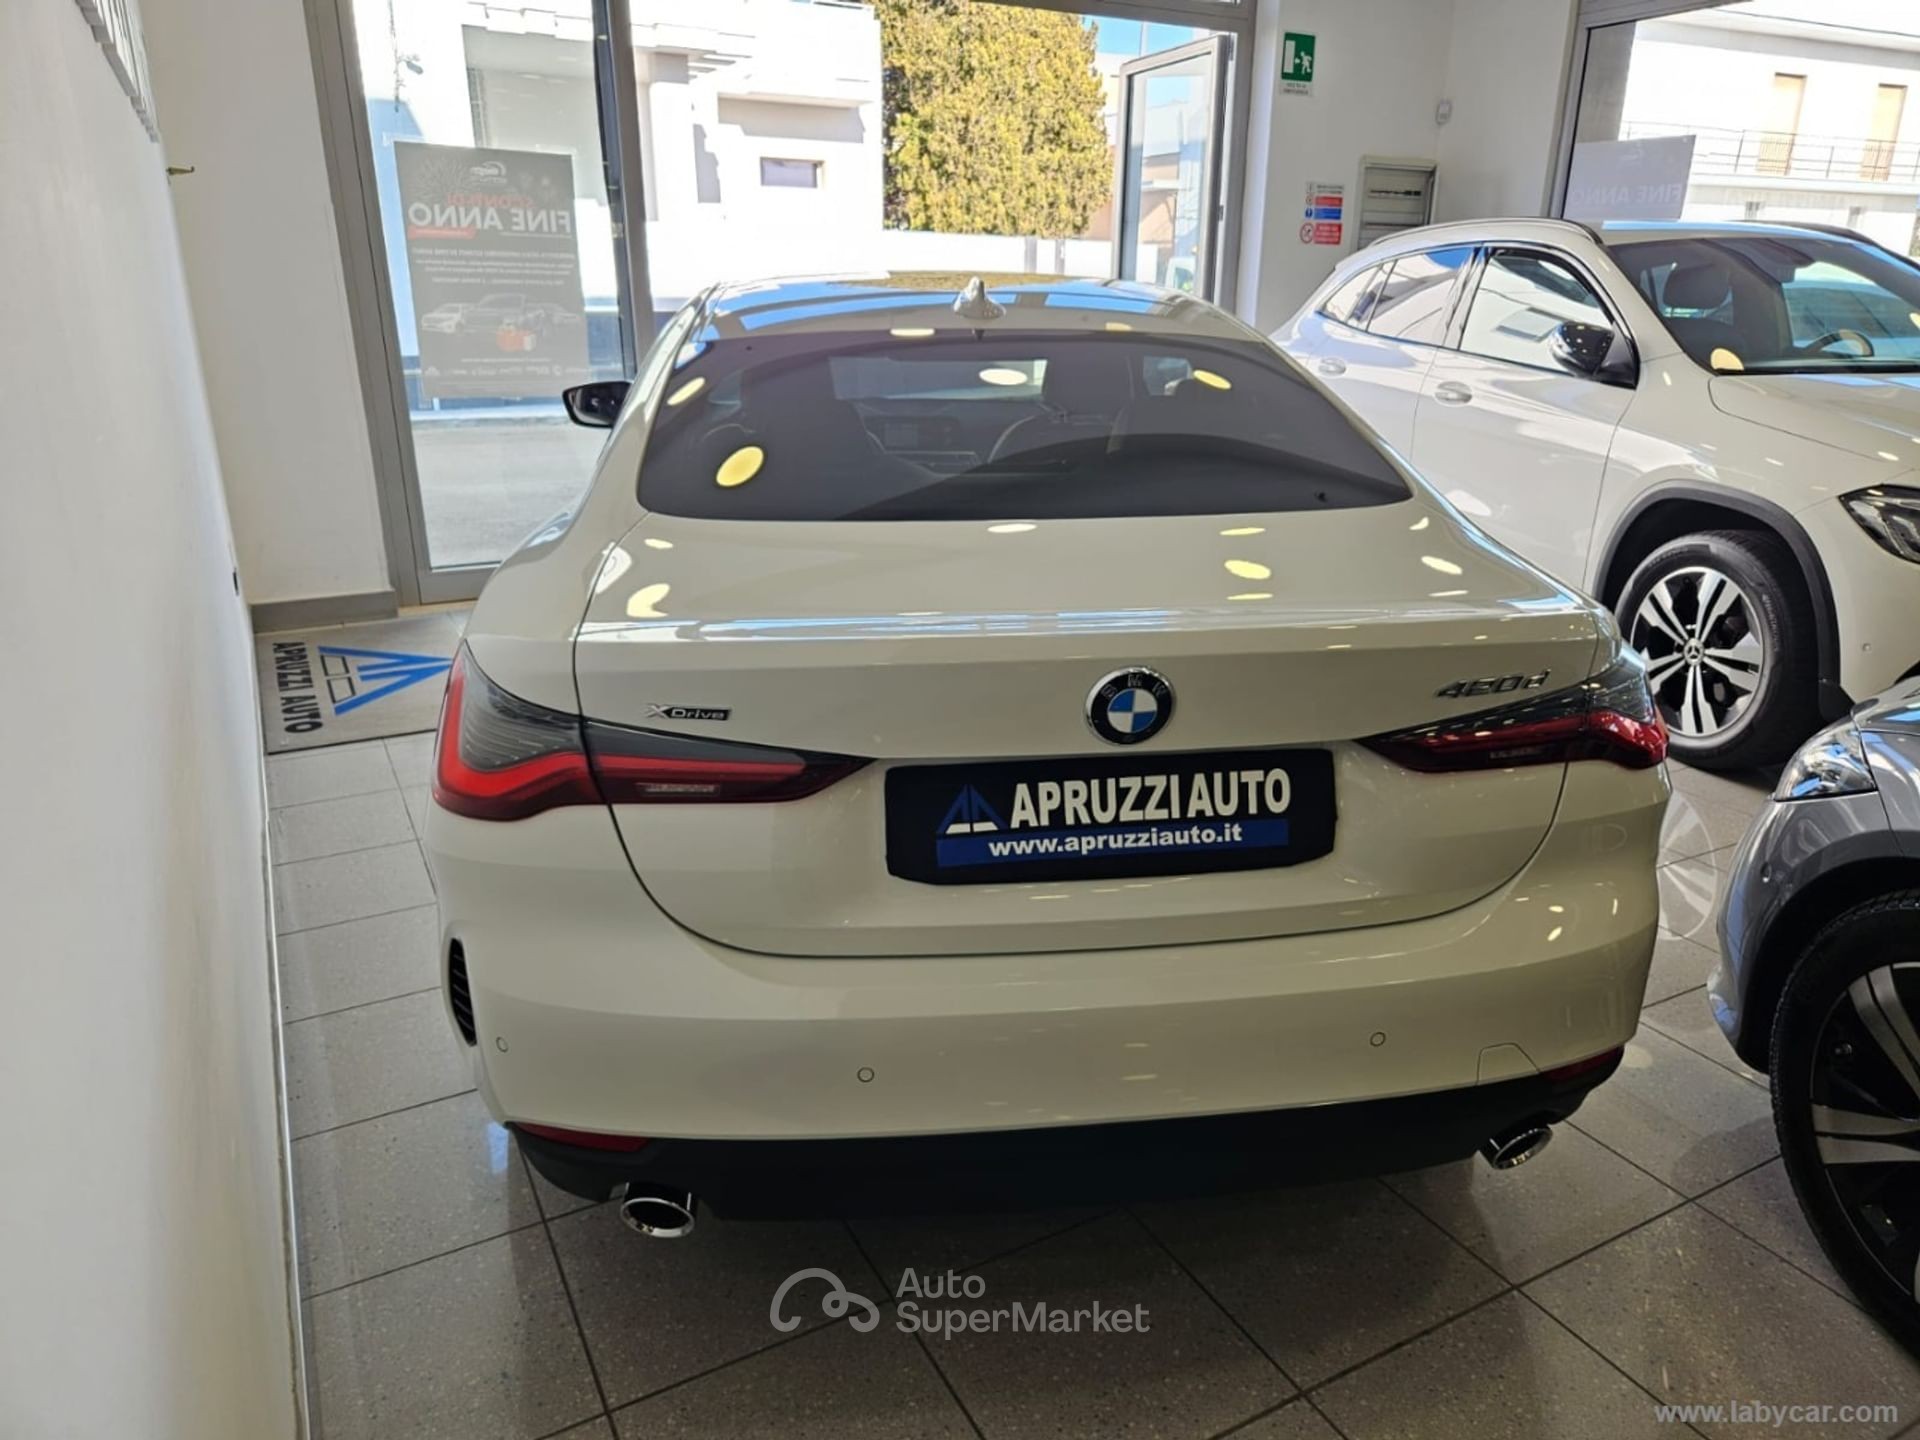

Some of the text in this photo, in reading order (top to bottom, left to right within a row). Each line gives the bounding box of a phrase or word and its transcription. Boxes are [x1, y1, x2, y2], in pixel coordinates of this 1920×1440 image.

[272, 641, 323, 733] APRUZZI AUTO
[1434, 668, 1551, 698] 420d
[1010, 768, 1291, 829] APRUZZI AUTO
[988, 823, 1243, 857] www.apruzziauto.it
